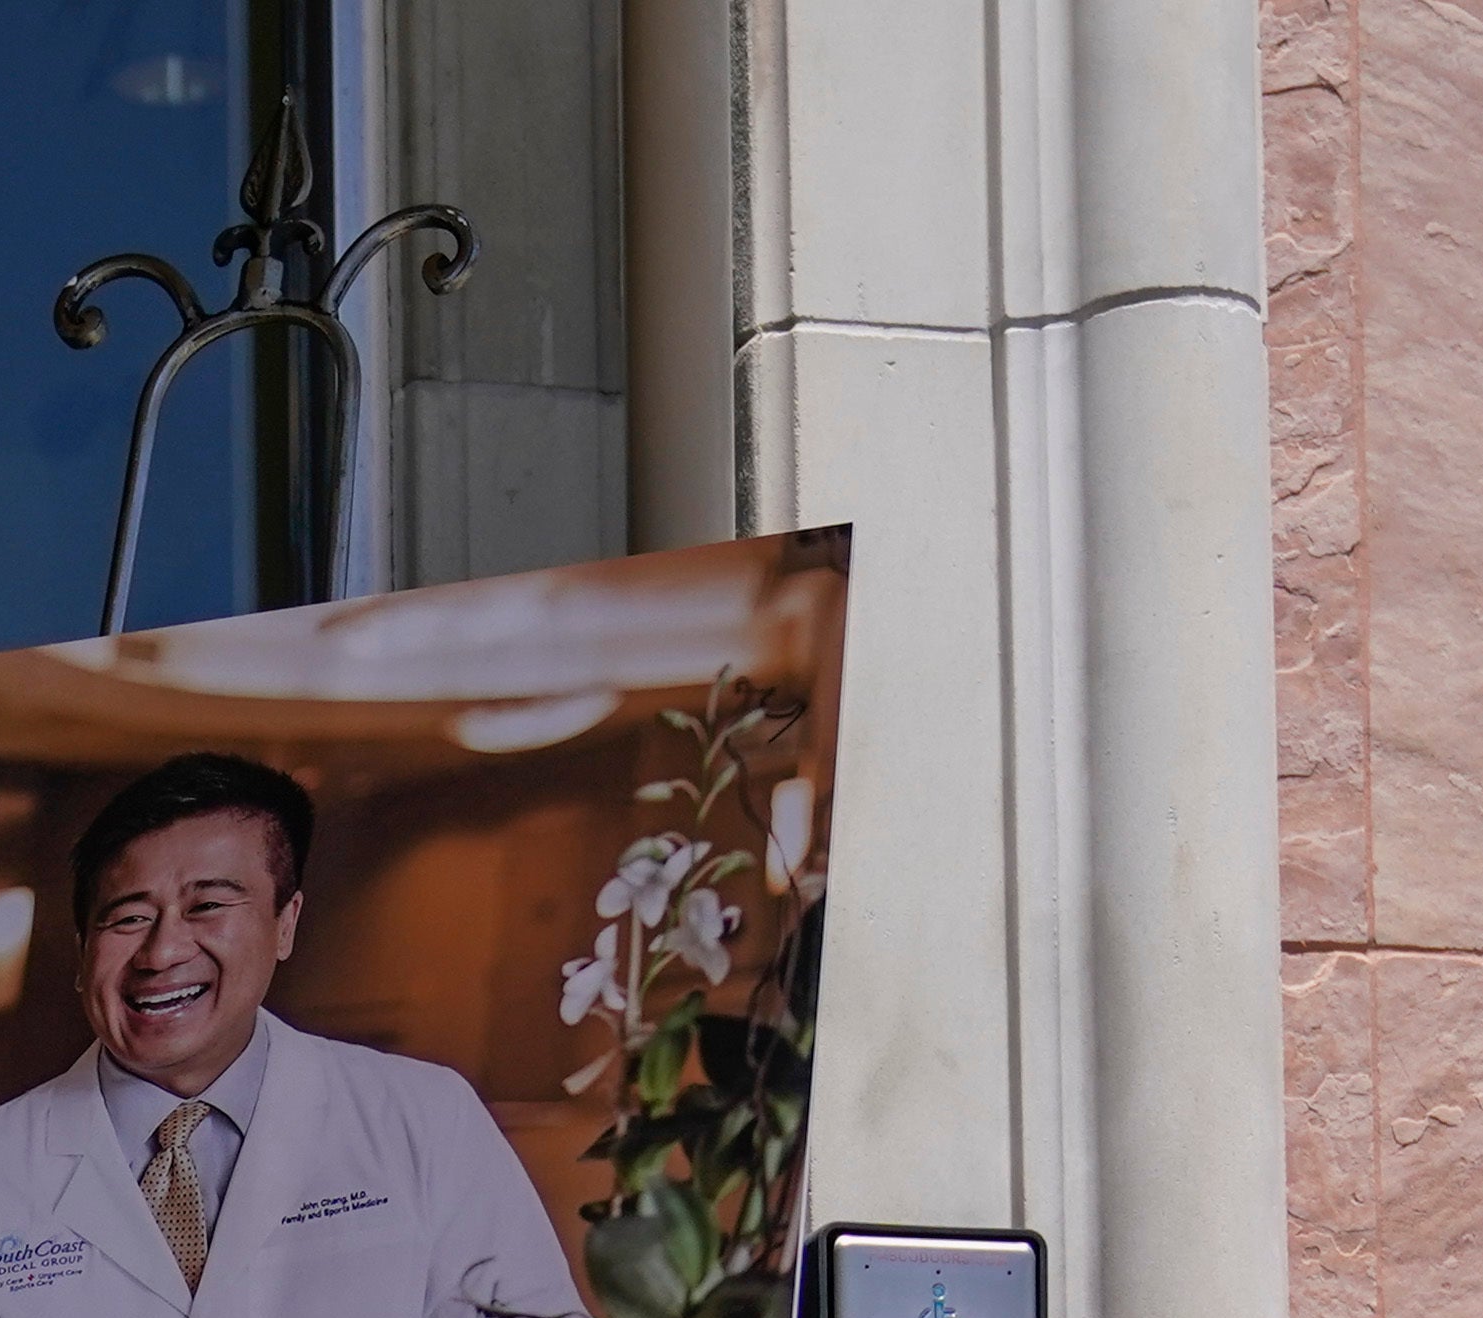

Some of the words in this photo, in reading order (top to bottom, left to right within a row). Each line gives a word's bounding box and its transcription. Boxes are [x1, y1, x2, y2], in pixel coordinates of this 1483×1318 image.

[41, 1255, 84, 1268] GROUP
[6, 1276, 24, 1286] Care
[65, 1268, 83, 1276] Care
[36, 1279, 54, 1288] Care
